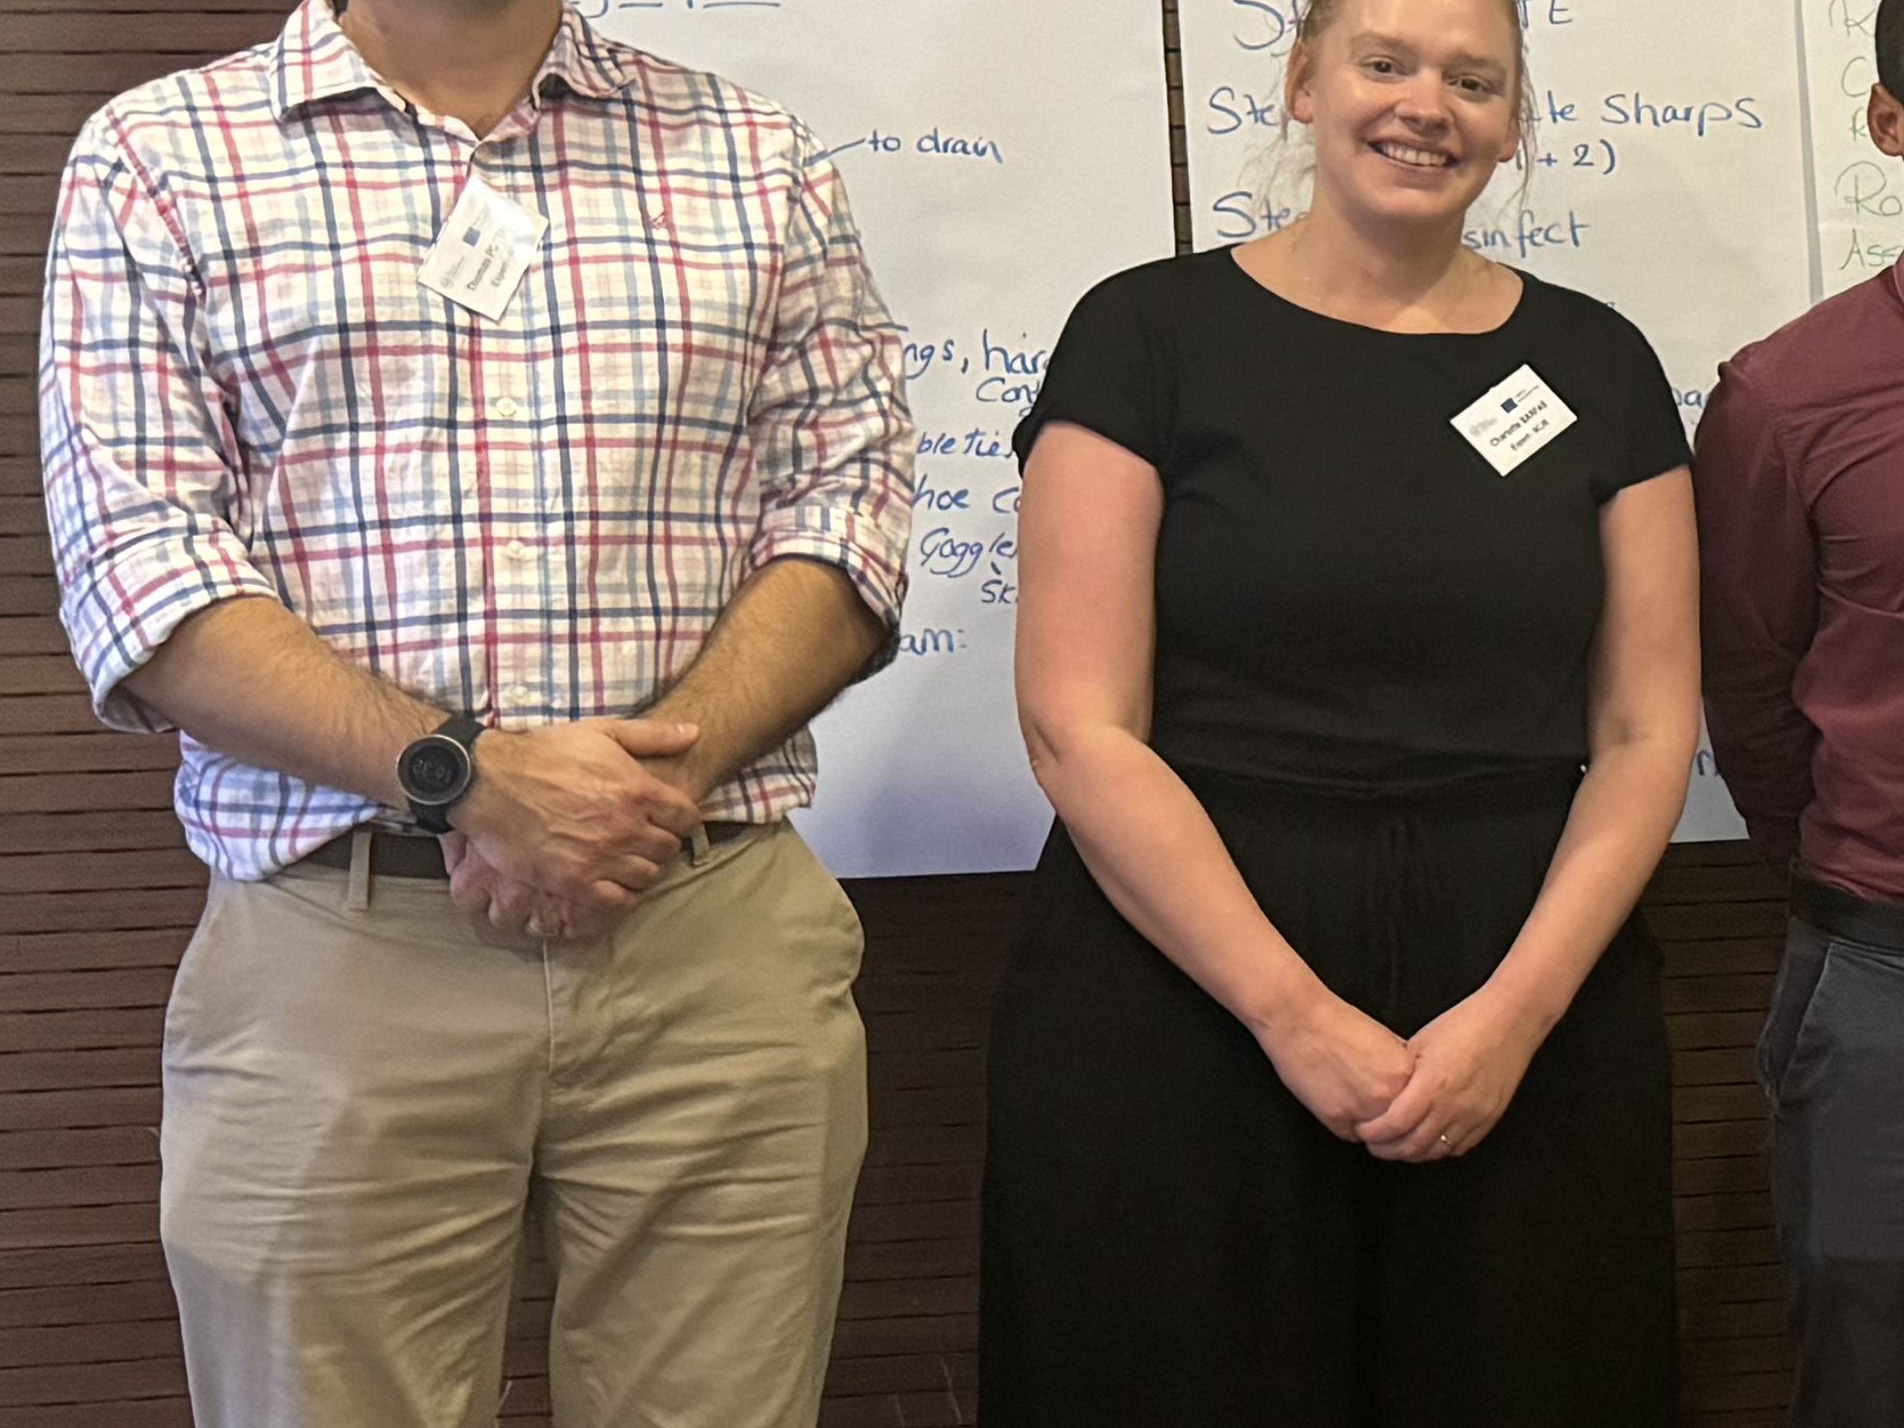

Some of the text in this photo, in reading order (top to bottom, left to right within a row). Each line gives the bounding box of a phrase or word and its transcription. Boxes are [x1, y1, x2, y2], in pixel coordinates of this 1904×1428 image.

[1599, 90, 1763, 138] Sharps
[866, 126, 1004, 165] to drain
[1460, 208, 1591, 260] sinfect
